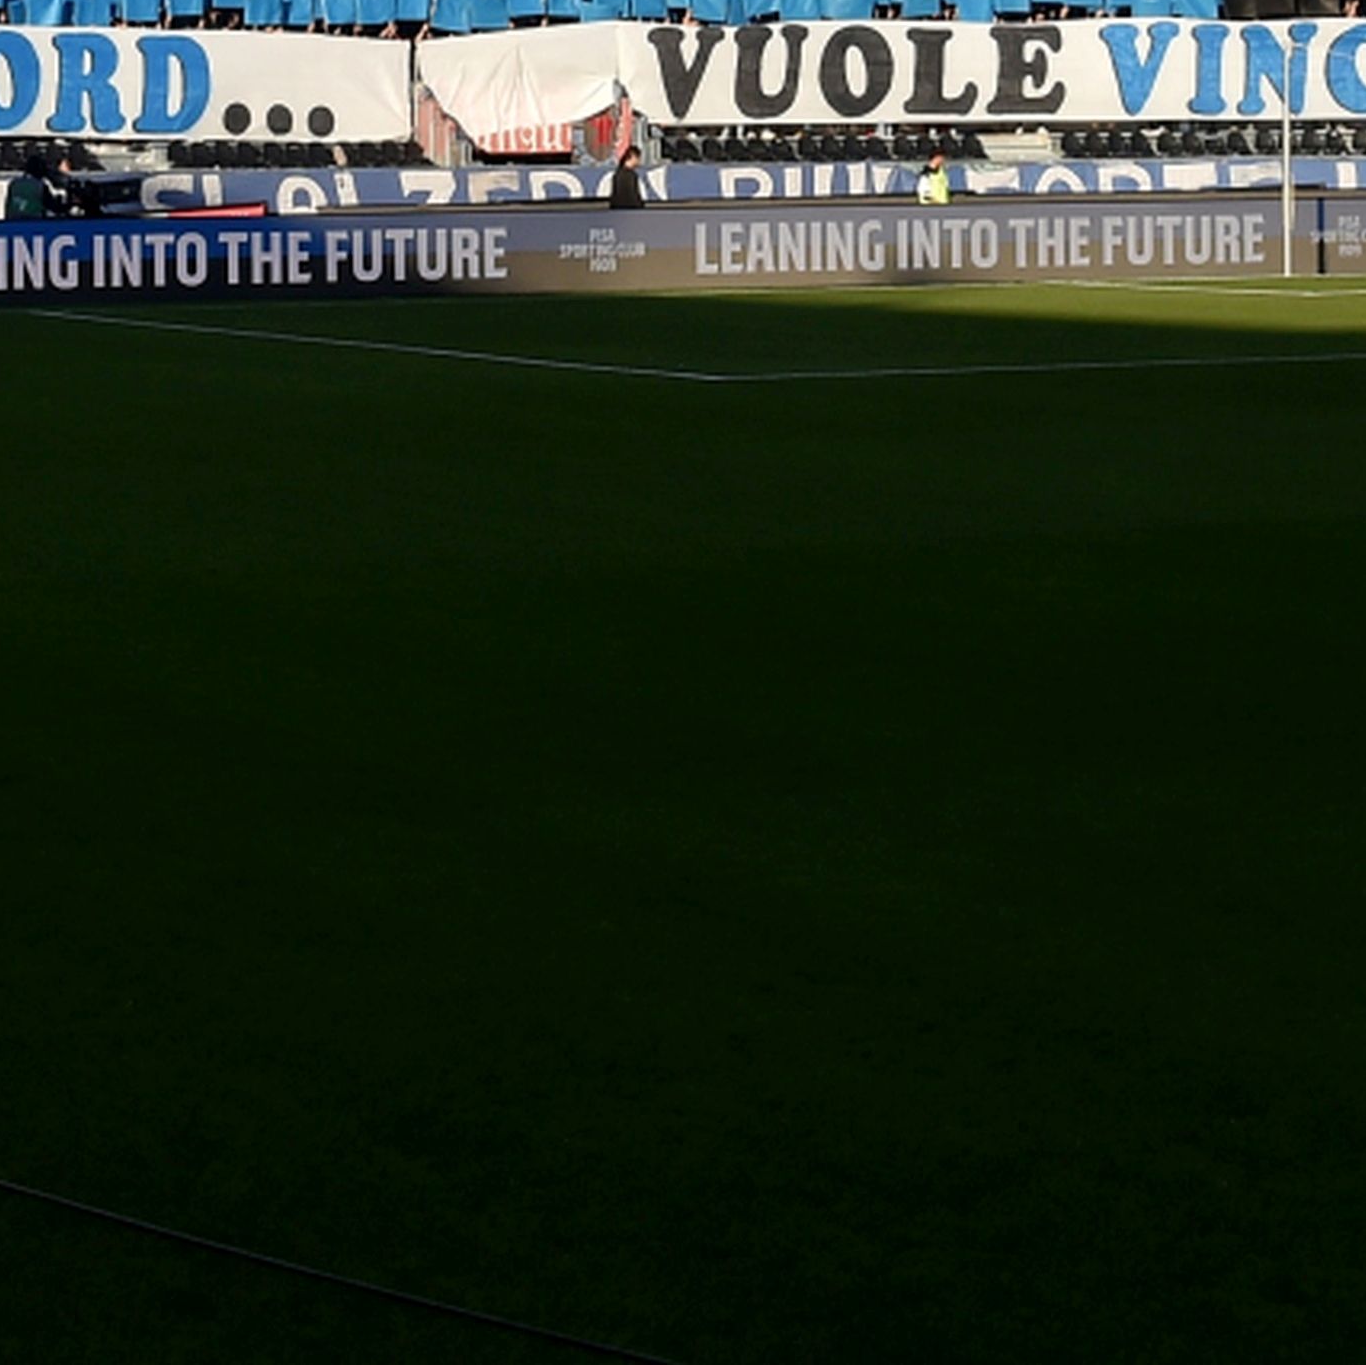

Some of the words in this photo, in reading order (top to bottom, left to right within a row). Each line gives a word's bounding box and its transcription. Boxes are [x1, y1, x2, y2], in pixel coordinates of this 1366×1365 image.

[648, 24, 1067, 119] VUOLE
[93, 231, 208, 288] INTO
[218, 231, 312, 286] THE
[325, 227, 508, 284] FUTURE
[695, 219, 885, 275] LEANING
[896, 218, 998, 270] INTO
[1008, 216, 1091, 268] THE
[1101, 213, 1265, 266] FUTURE
